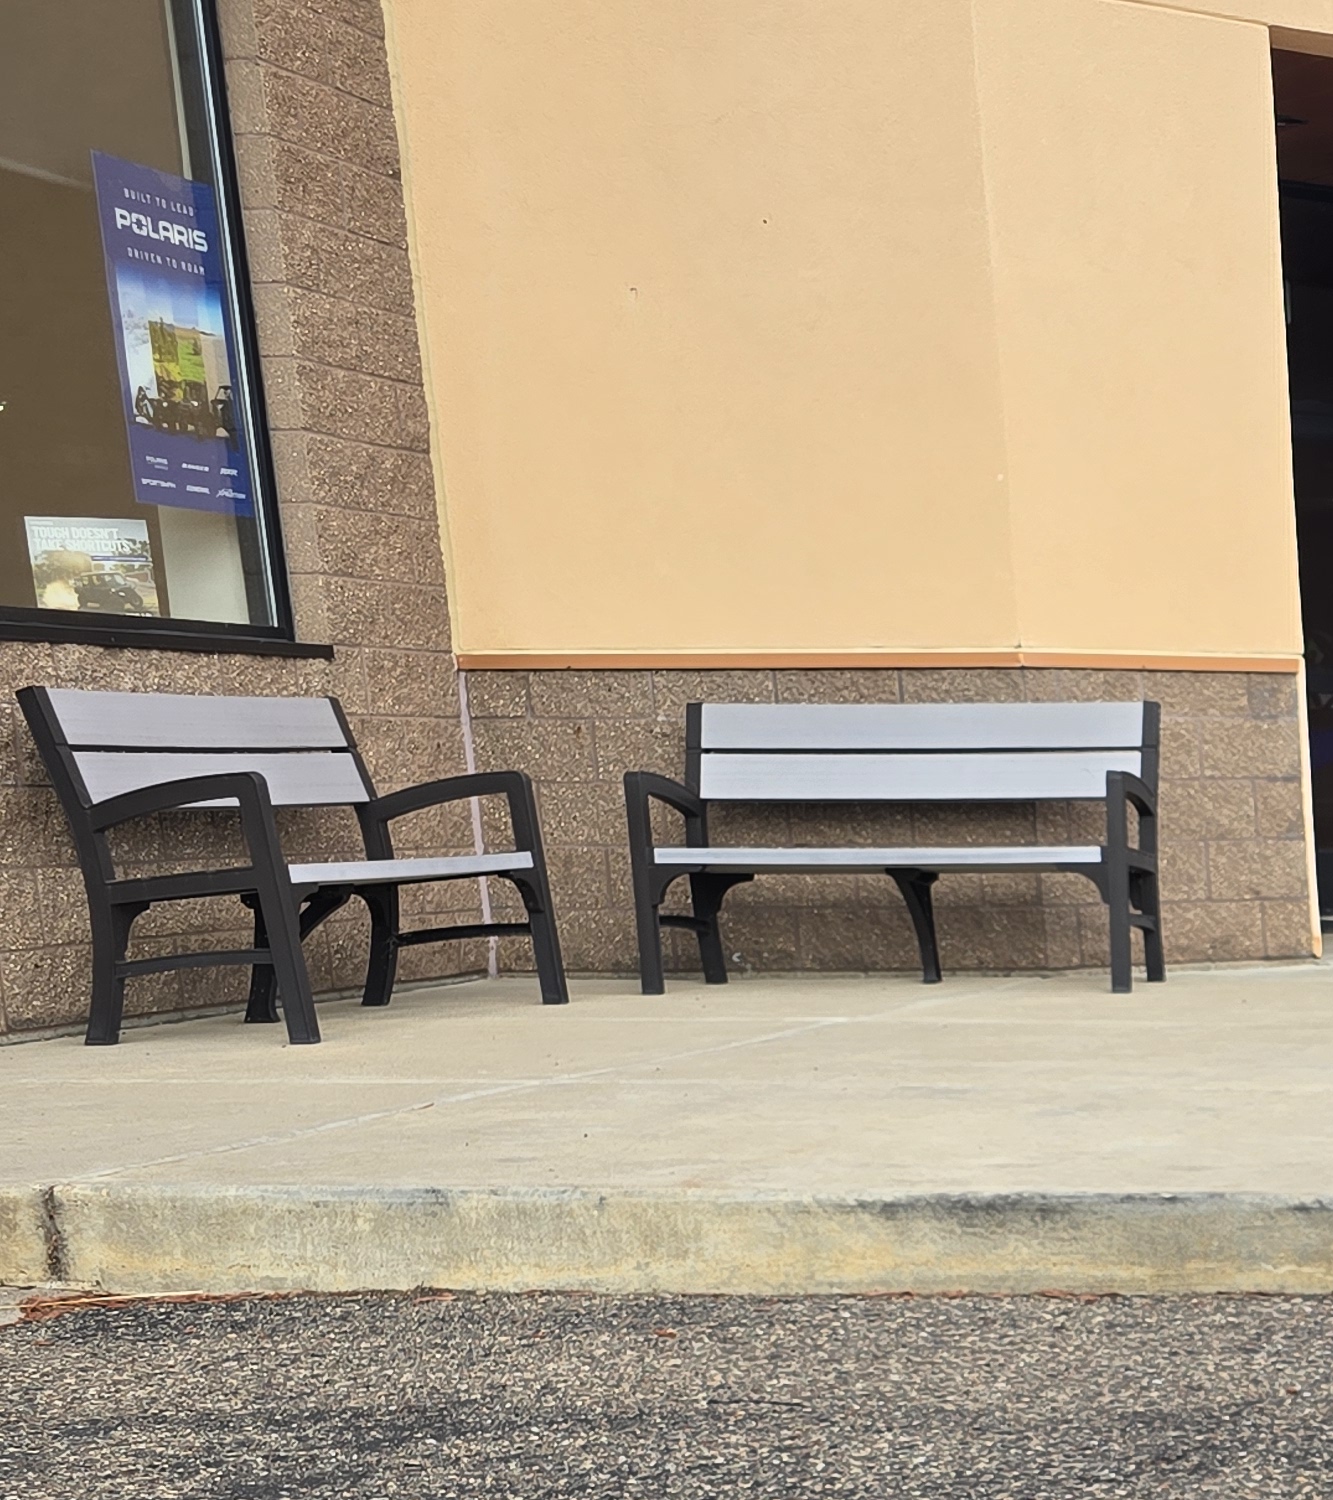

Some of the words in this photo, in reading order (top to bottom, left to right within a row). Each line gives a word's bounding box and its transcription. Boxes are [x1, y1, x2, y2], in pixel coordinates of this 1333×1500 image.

[123, 187, 151, 204] BUILT
[155, 196, 167, 209] TO
[170, 201, 194, 217] LEAD
[114, 207, 208, 253] POLARIS
[127, 247, 163, 265] DRIVEN
[166, 257, 178, 269] TO
[181, 261, 205, 276] ROAM
[30, 525, 69, 539] TOUGH
[70, 526, 119, 540] DOESN'T
[32, 538, 65, 551] TAKE
[65, 539, 132, 553] SHORTCUTS
